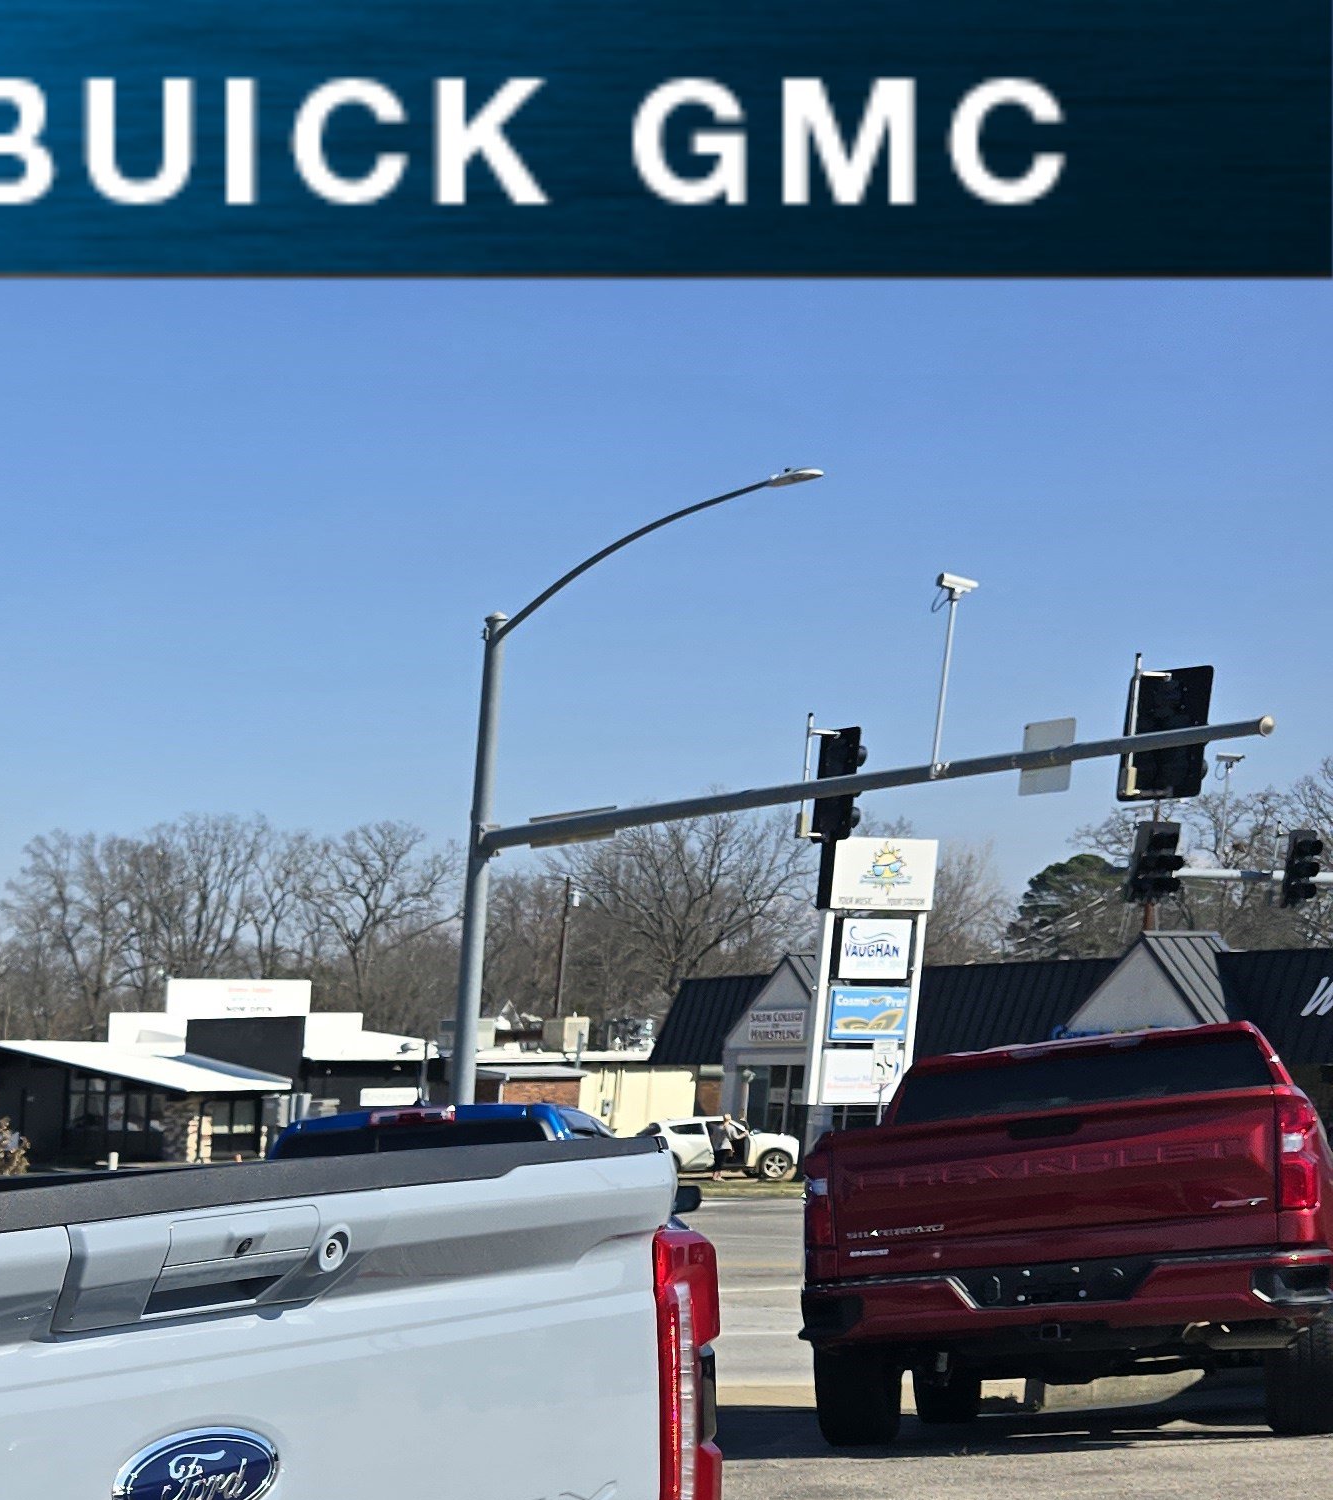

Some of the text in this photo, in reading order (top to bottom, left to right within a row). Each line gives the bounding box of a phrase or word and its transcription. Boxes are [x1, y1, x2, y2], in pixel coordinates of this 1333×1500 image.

[844, 942, 901, 960] VAUGHAN
[835, 993, 908, 1008] Cosmo Prof
